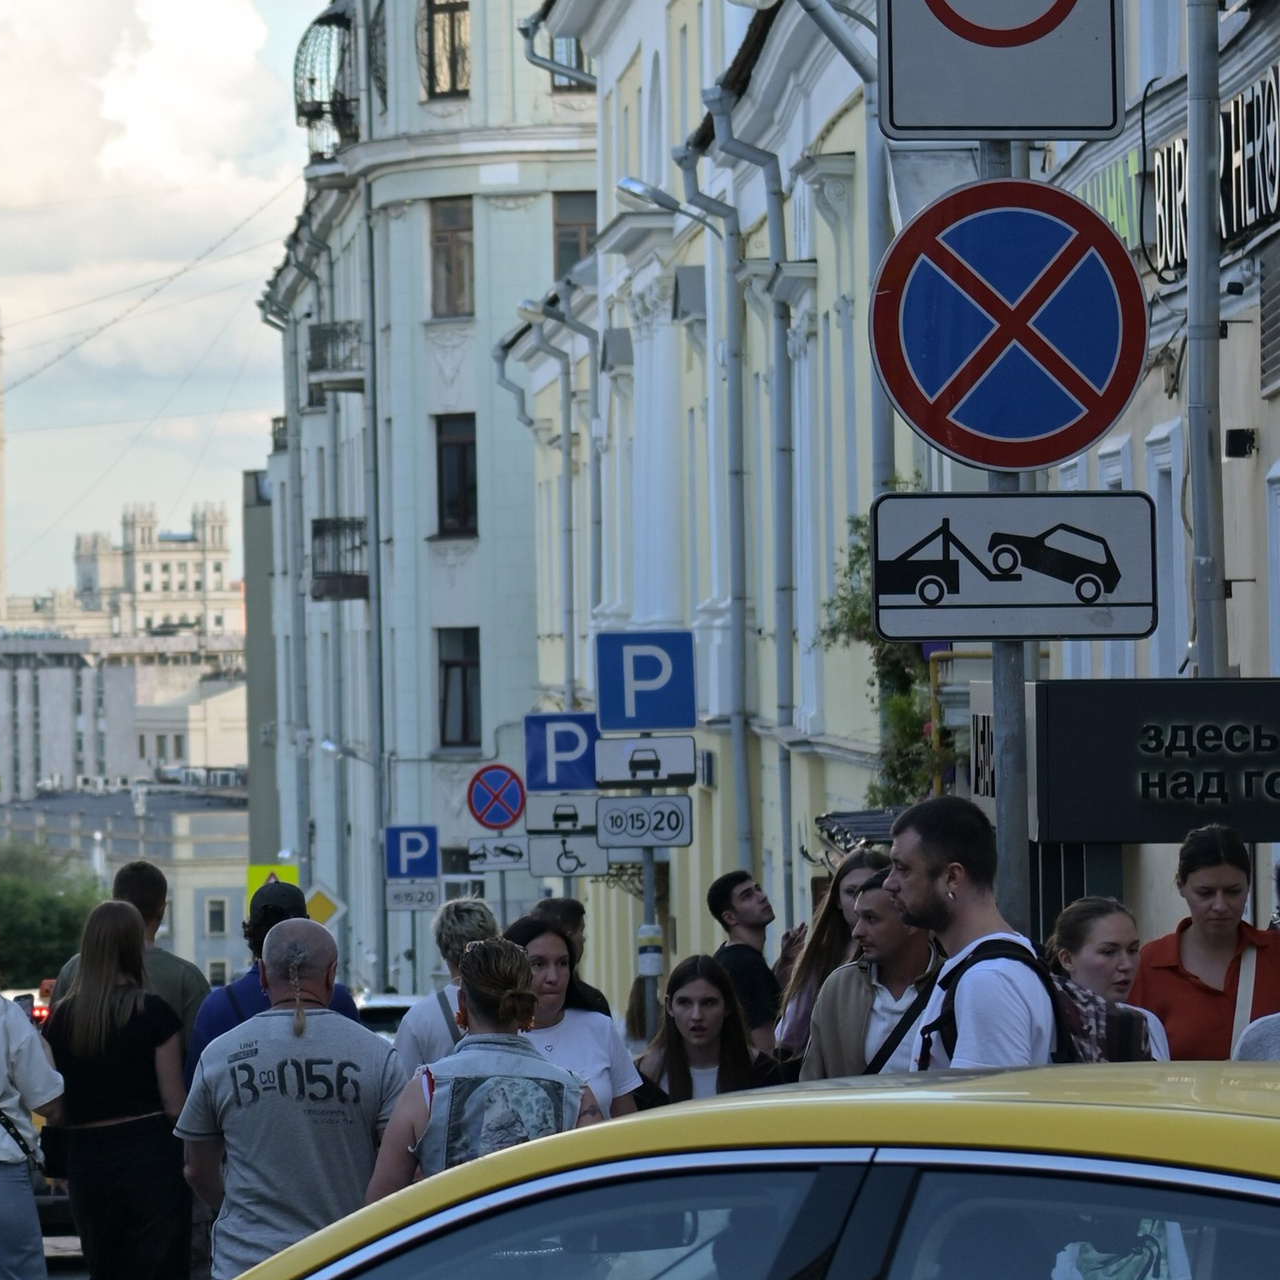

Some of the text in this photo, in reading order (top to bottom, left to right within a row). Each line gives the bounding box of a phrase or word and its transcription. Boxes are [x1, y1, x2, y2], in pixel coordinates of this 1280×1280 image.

[1231, 65, 1280, 233] HERO
[622, 644, 673, 718] P
[545, 722, 588, 783] P
[1140, 771, 1228, 805] над
[609, 809, 680, 832] 10 15 20
[400, 831, 429, 874] P
[418, 891, 434, 903] 20
[239, 1040, 259, 1050] UNIT
